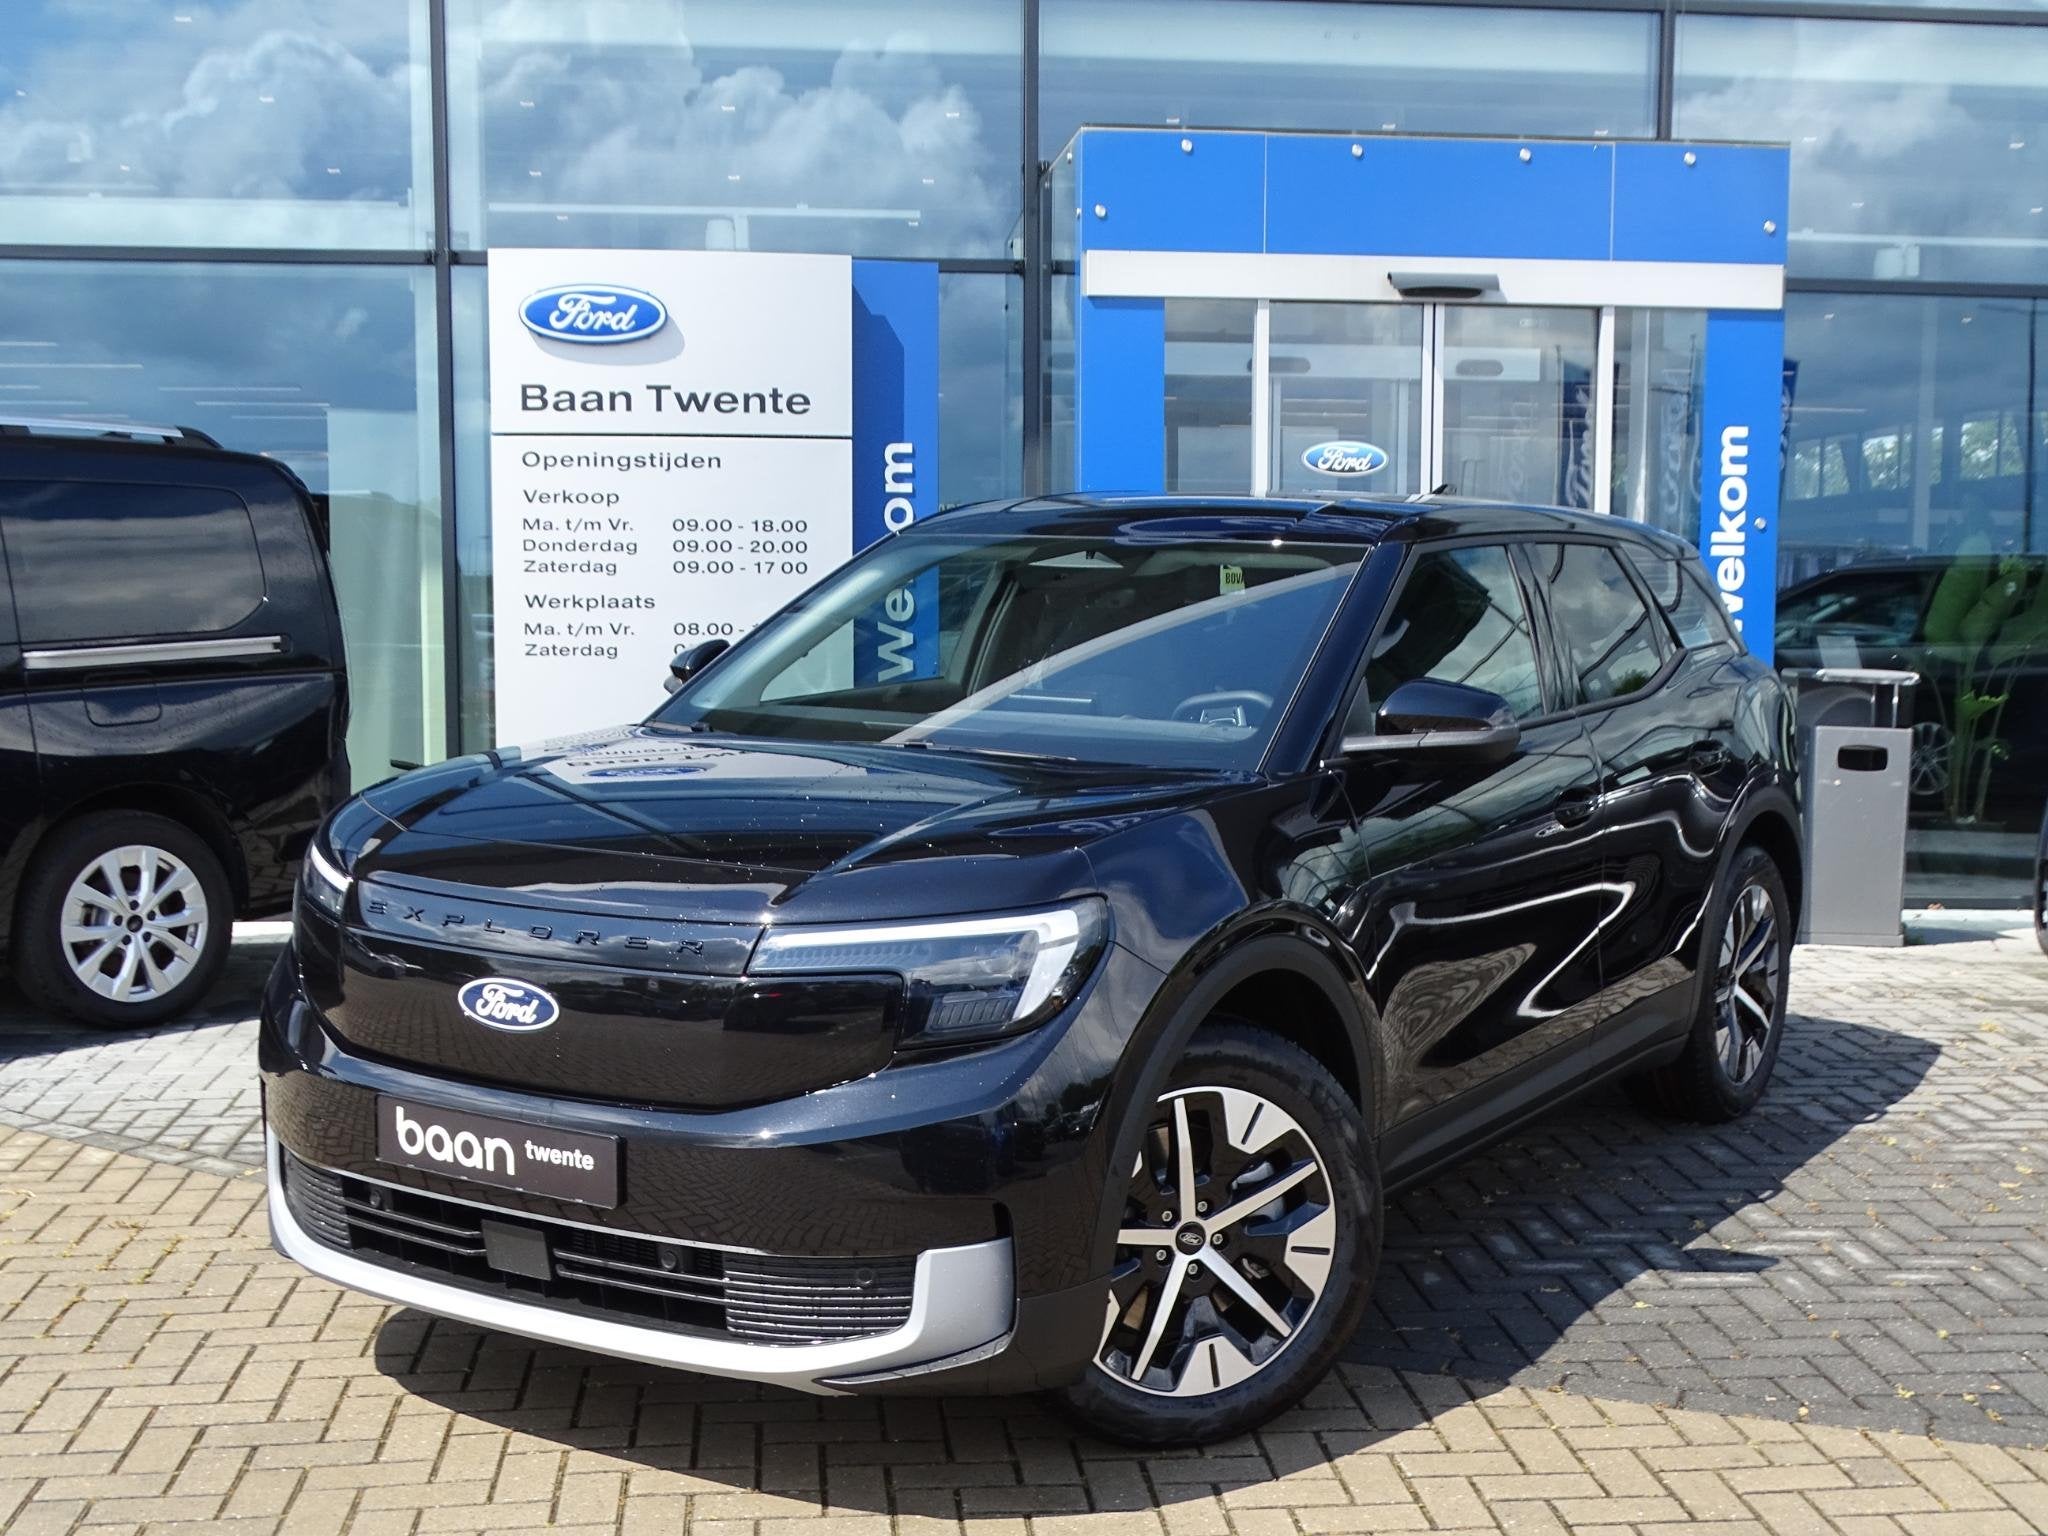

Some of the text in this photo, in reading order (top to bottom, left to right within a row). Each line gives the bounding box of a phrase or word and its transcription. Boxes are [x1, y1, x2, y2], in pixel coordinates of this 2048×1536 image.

[549, 292, 638, 331] Ford
[521, 384, 811, 415] Baan Twente
[522, 451, 722, 472] Openingstijden
[1317, 446, 1373, 471] Ford
[523, 489, 620, 507] Verkoop
[522, 517, 560, 531] Ma.
[566, 517, 602, 533] t/m
[608, 517, 634, 531] Vr.
[672, 518, 733, 532] 09.00
[752, 519, 808, 533] 18.00
[522, 538, 638, 555] Donderdag
[672, 539, 733, 553] 09.00
[749, 540, 808, 554] 20.00
[523, 559, 617, 576] Zaterdag
[672, 560, 734, 574] 09.00
[525, 594, 656, 612] Werkplaats
[524, 622, 561, 636] Ma.
[567, 622, 603, 637] t/m
[609, 622, 635, 636] Vr.
[673, 622, 733, 636] 08.00
[525, 643, 618, 660] Zaterdag
[366, 900, 704, 955] EXPLORER
[476, 983, 540, 1025] Ford
[395, 1106, 595, 1175] baan twente
